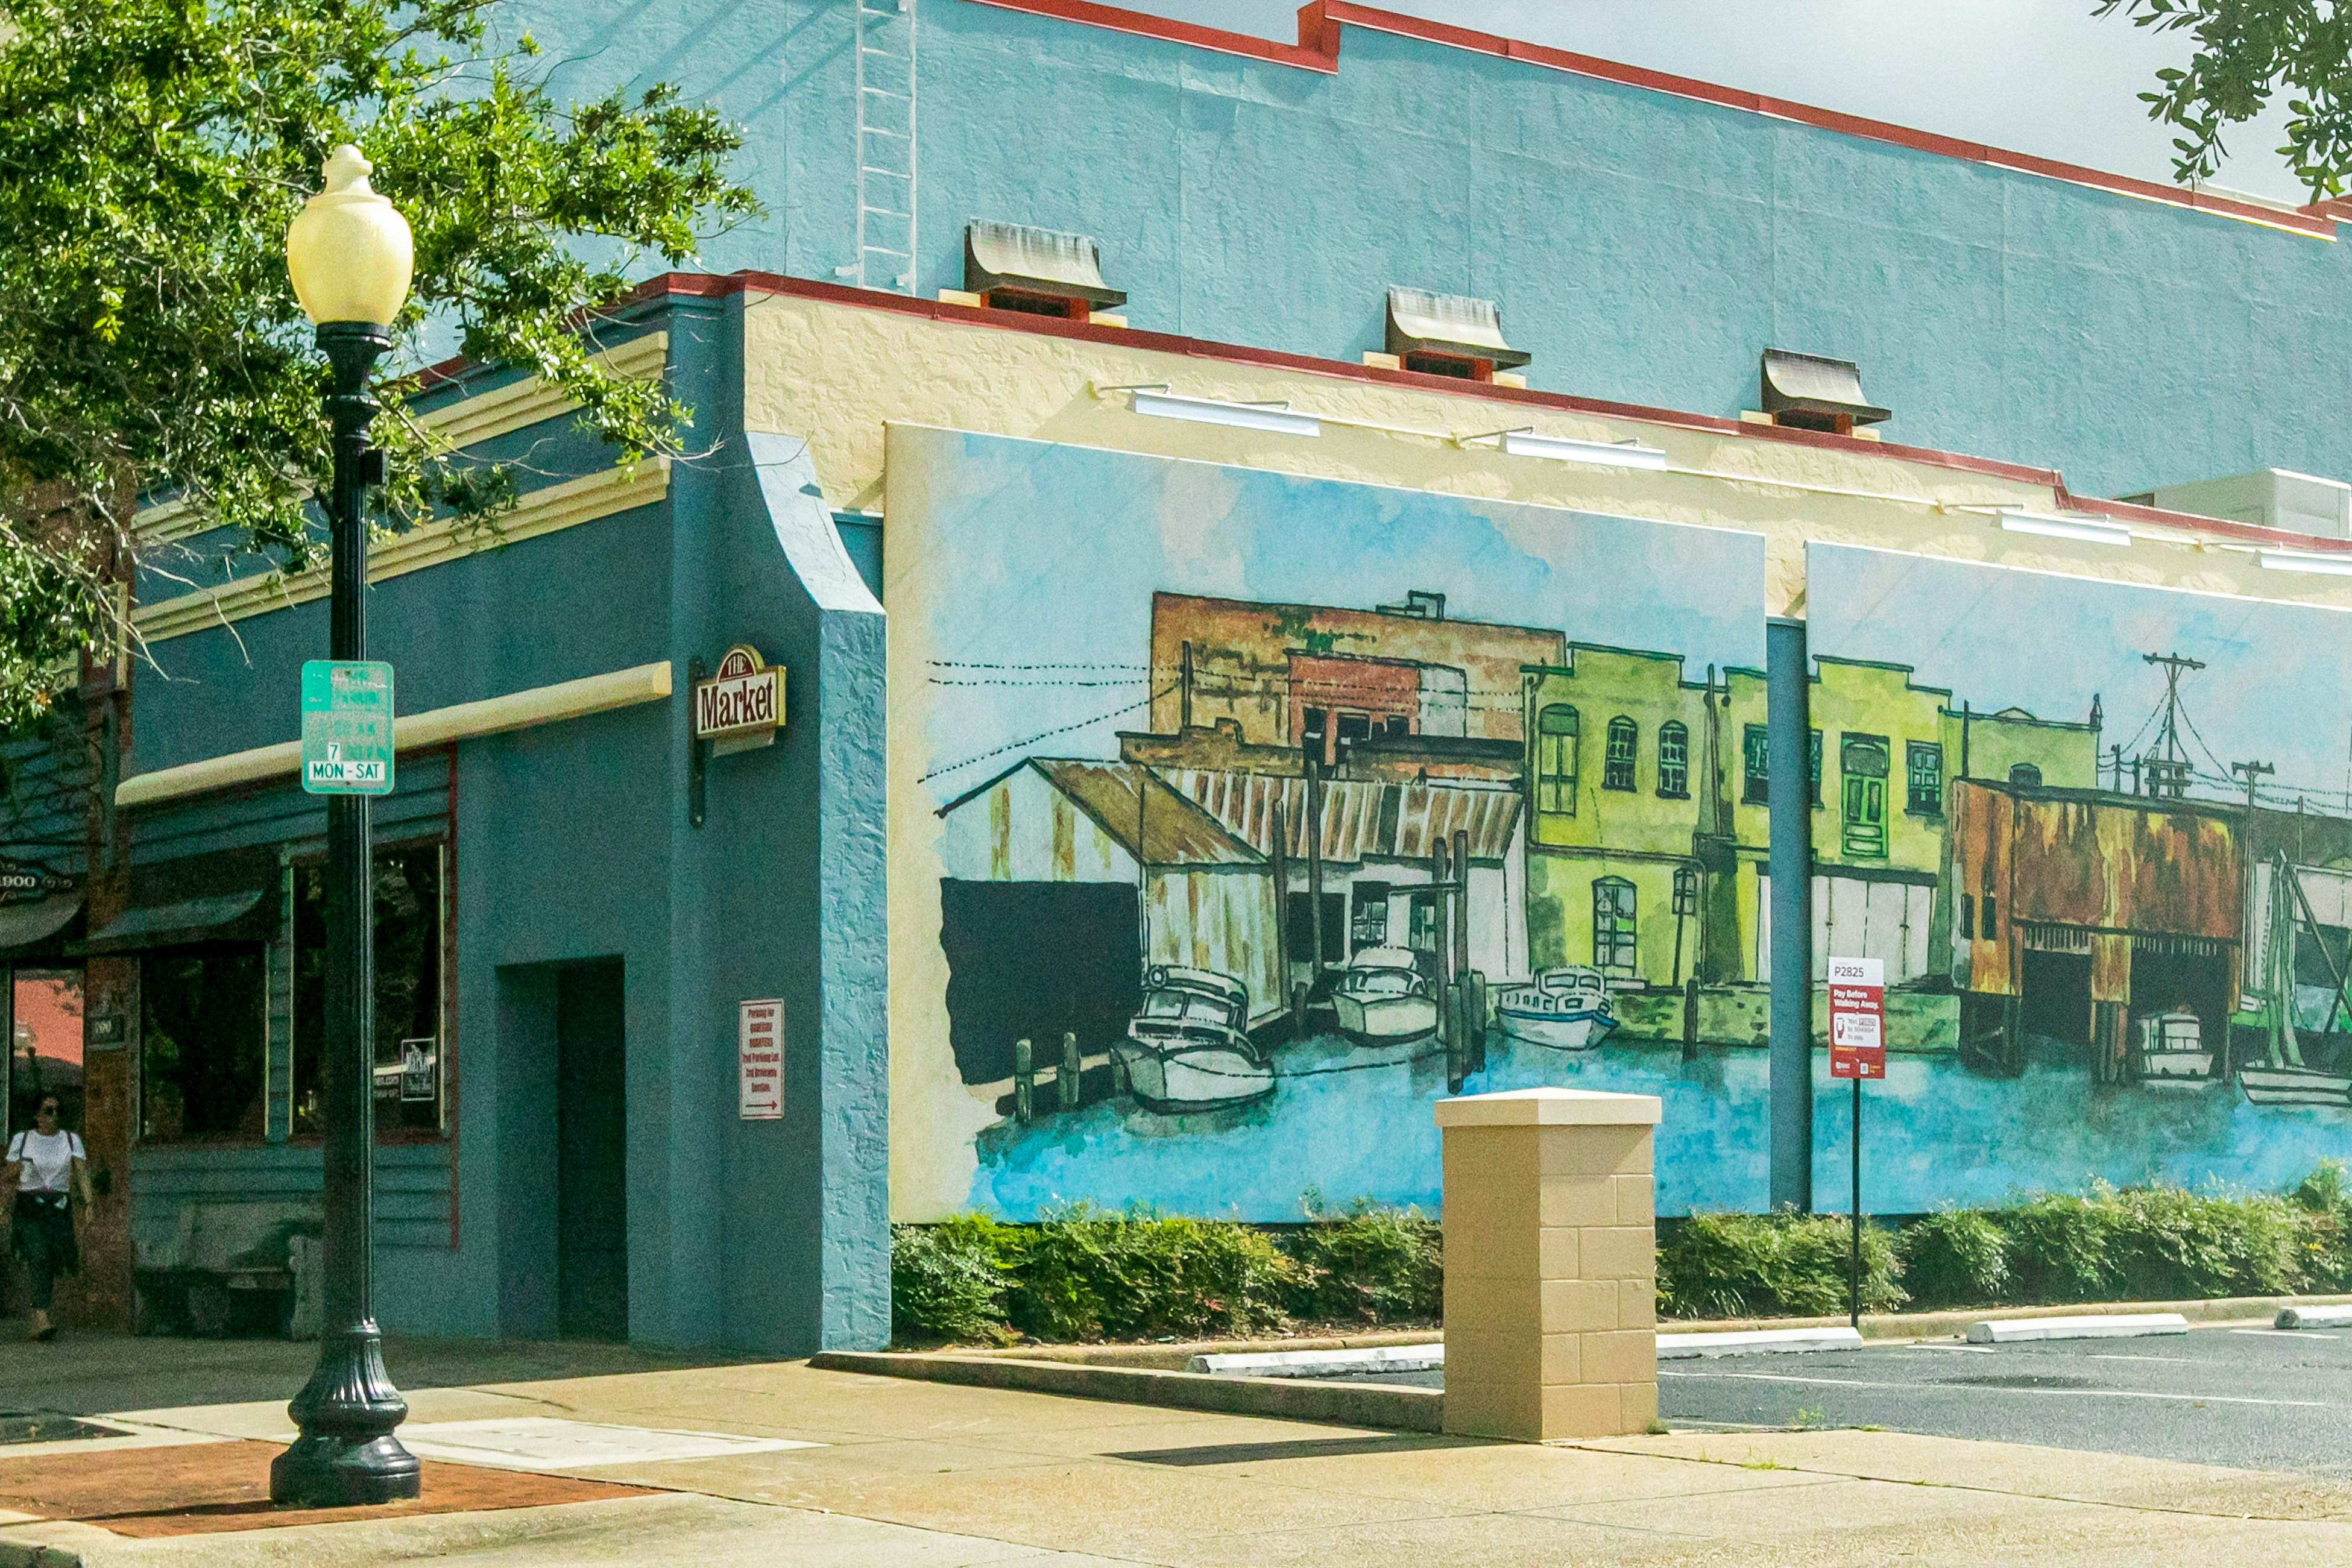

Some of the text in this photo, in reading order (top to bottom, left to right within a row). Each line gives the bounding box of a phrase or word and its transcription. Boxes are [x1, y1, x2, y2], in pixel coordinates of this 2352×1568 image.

[728, 655, 747, 676] THE
[700, 676, 774, 731] Market
[330, 744, 338, 760] 7
[1834, 966, 1864, 977] P2825
[1833, 989, 1868, 999] Pay Before
[1833, 998, 1860, 1009] Walking
